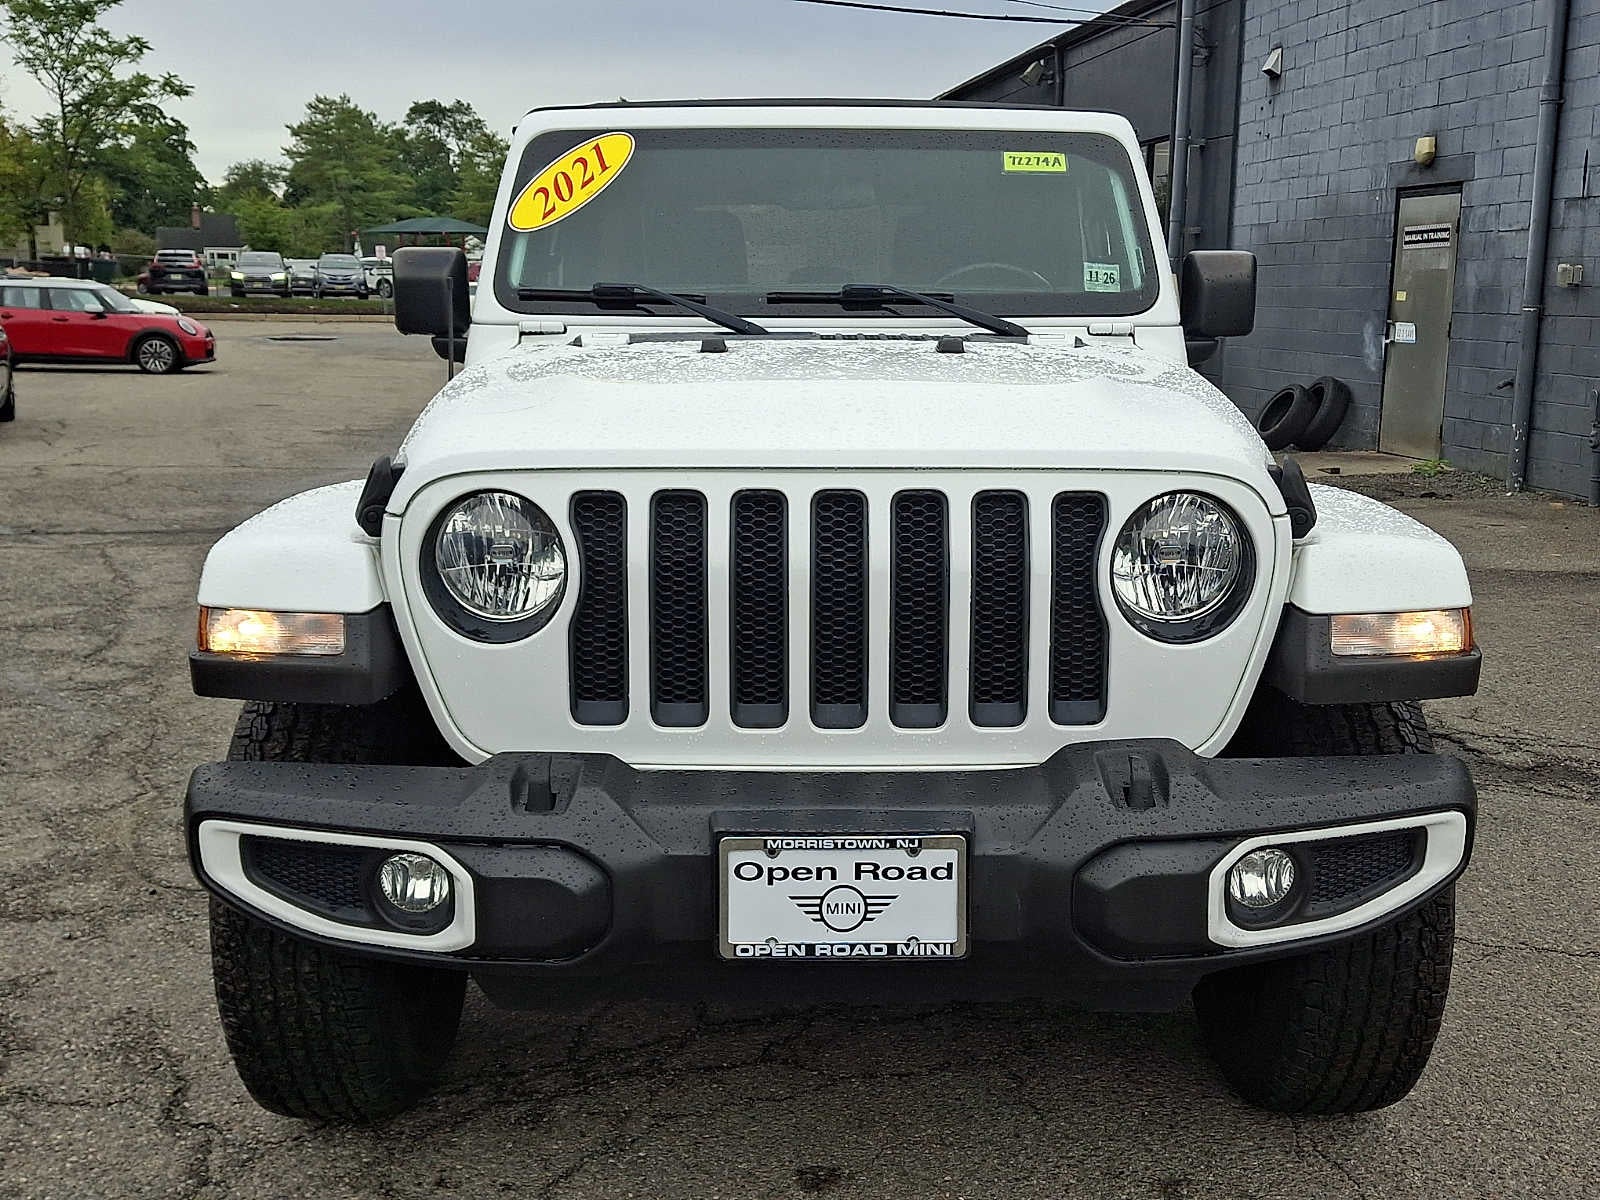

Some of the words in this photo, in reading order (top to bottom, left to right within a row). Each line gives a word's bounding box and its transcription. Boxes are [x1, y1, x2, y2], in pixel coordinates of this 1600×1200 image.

[532, 142, 612, 221] 2021
[1428, 231, 1450, 239] TRAINING
[1088, 270, 1100, 282] 11
[1103, 271, 1116, 285] 26
[766, 839, 890, 849] MORRISTOWN,
[896, 839, 919, 849] NJ
[733, 861, 838, 886] Open
[854, 861, 954, 881] Road
[826, 902, 861, 915] MINI
[735, 945, 806, 957] OPEN
[815, 944, 888, 957] ROAD
[896, 944, 951, 956] MINI
